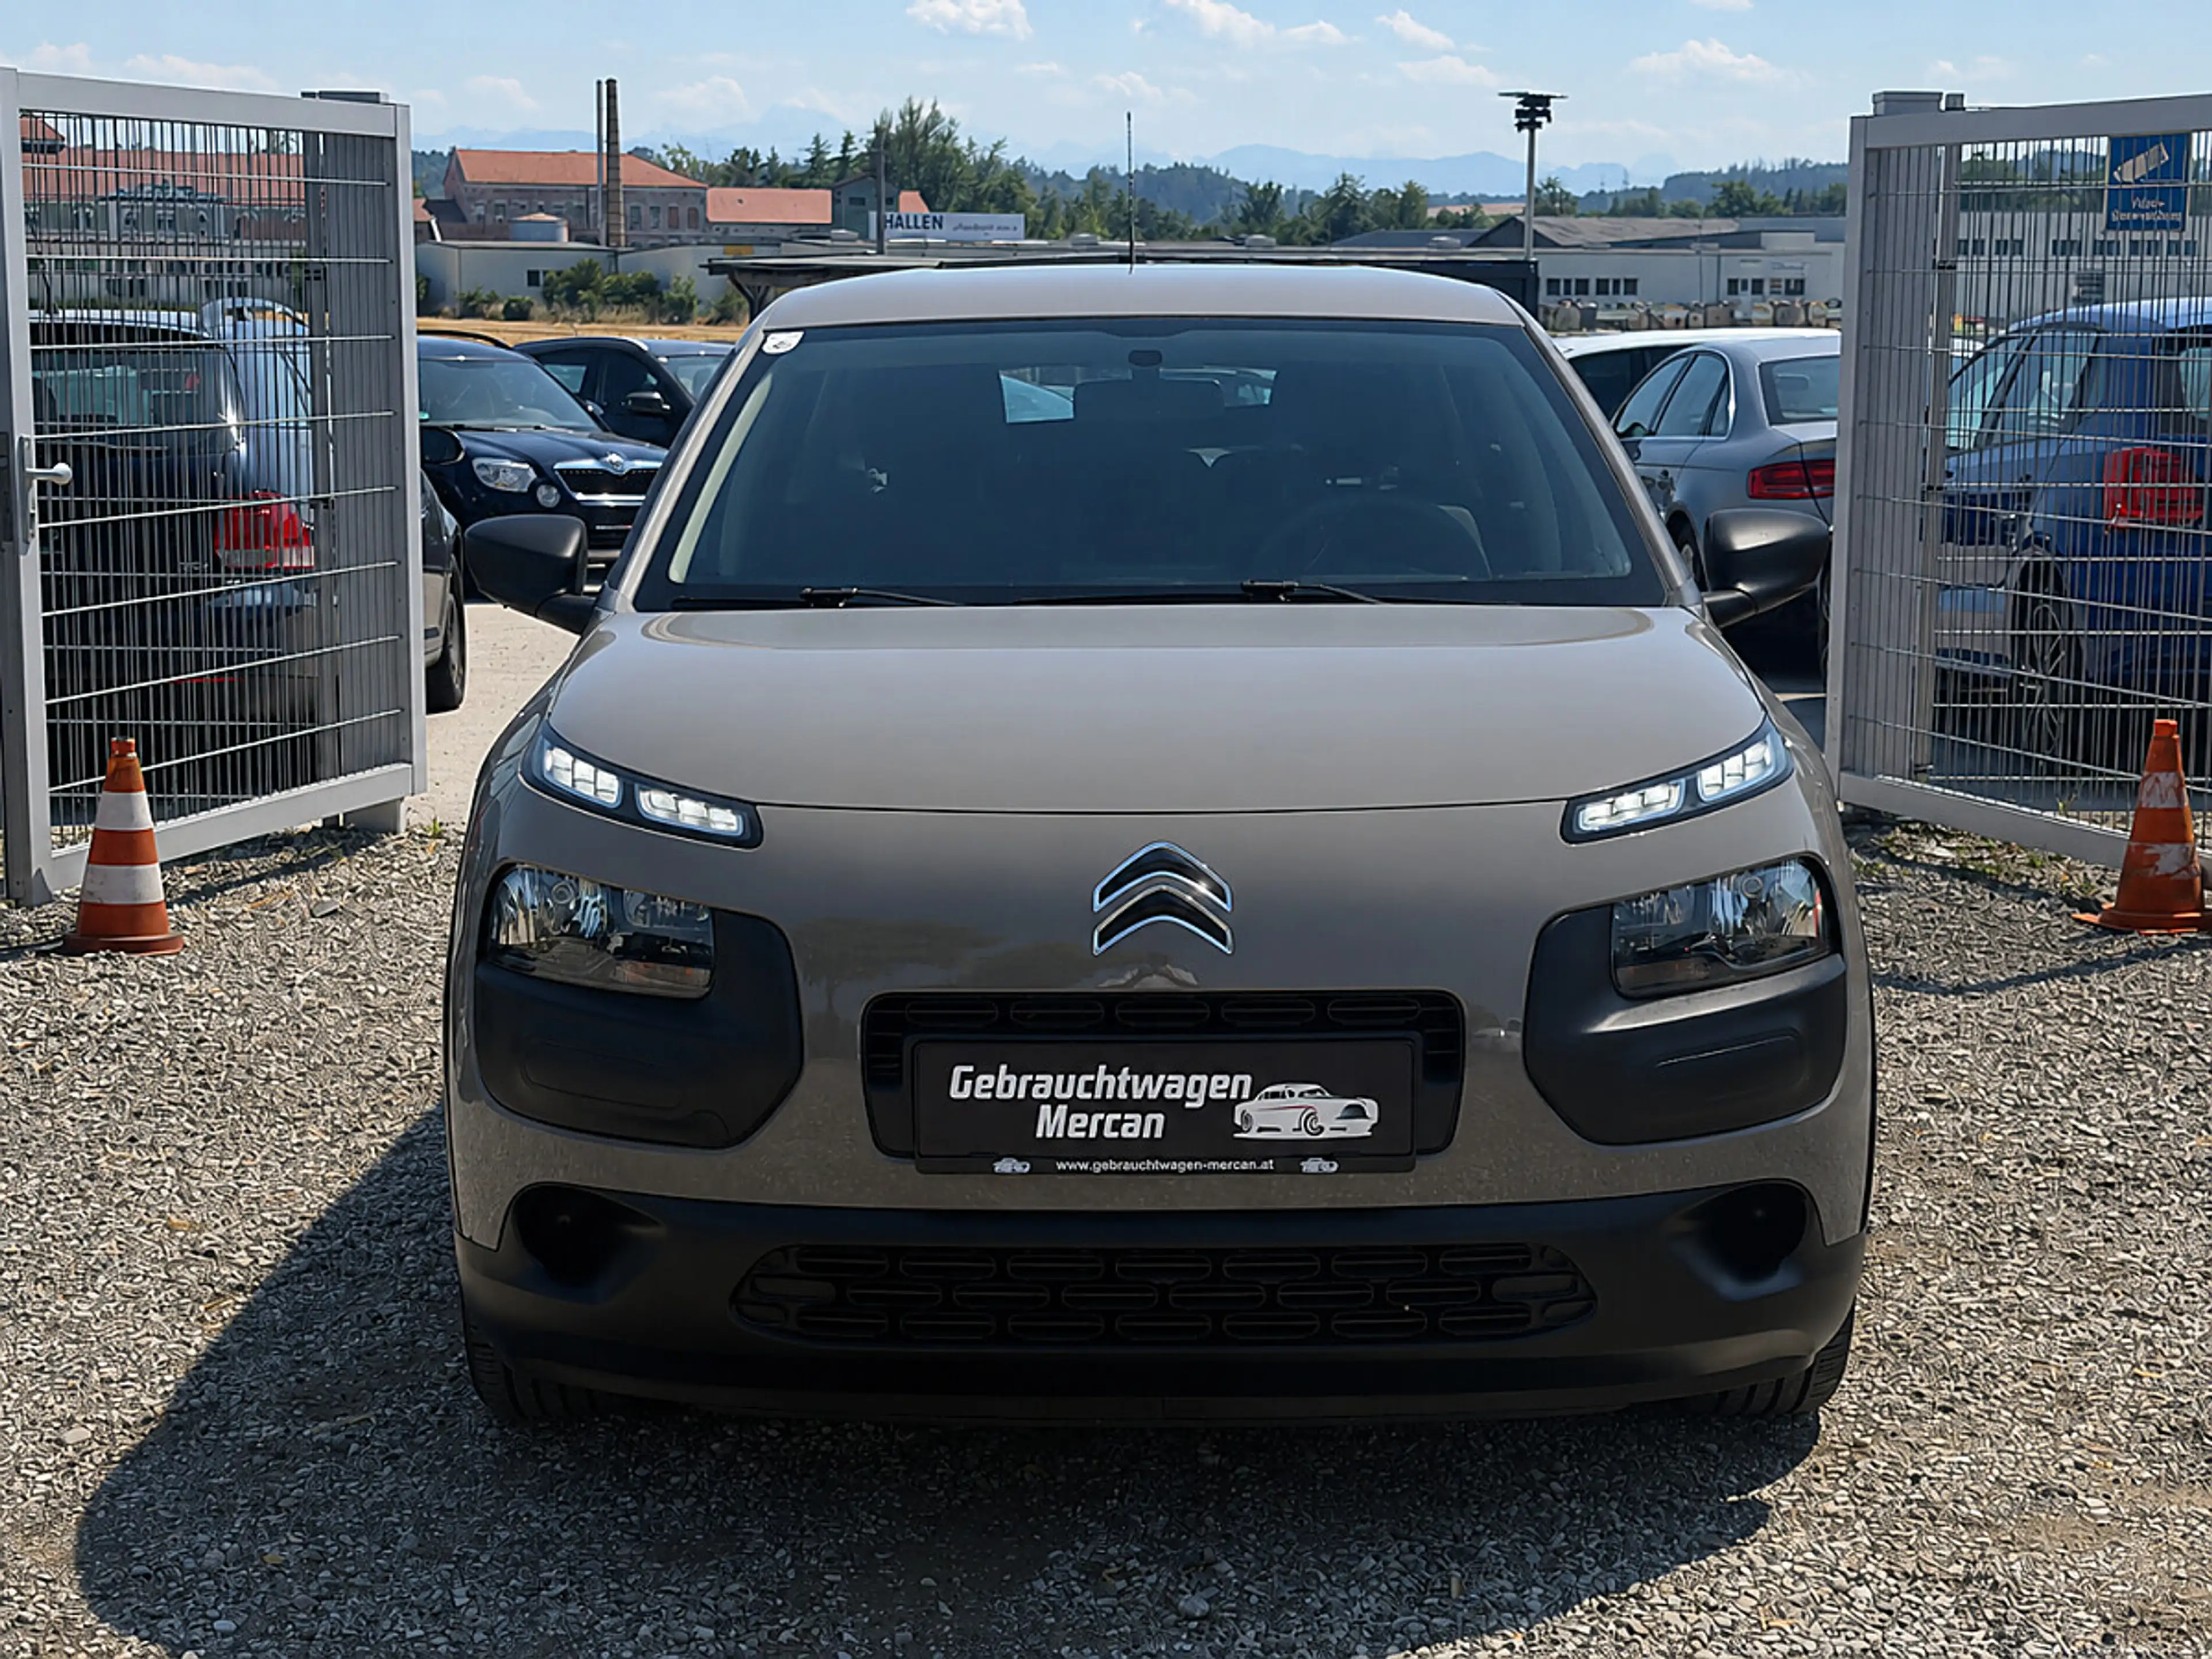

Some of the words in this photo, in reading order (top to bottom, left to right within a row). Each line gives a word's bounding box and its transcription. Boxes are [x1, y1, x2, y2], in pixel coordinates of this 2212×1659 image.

[885, 214, 944, 230] HALLEN
[949, 1064, 1252, 1108] Gebrauchtwagen
[1035, 1104, 1165, 1138] Mercan
[1056, 1159, 1275, 1173] www.gebrauchtwagen-mercan.at
